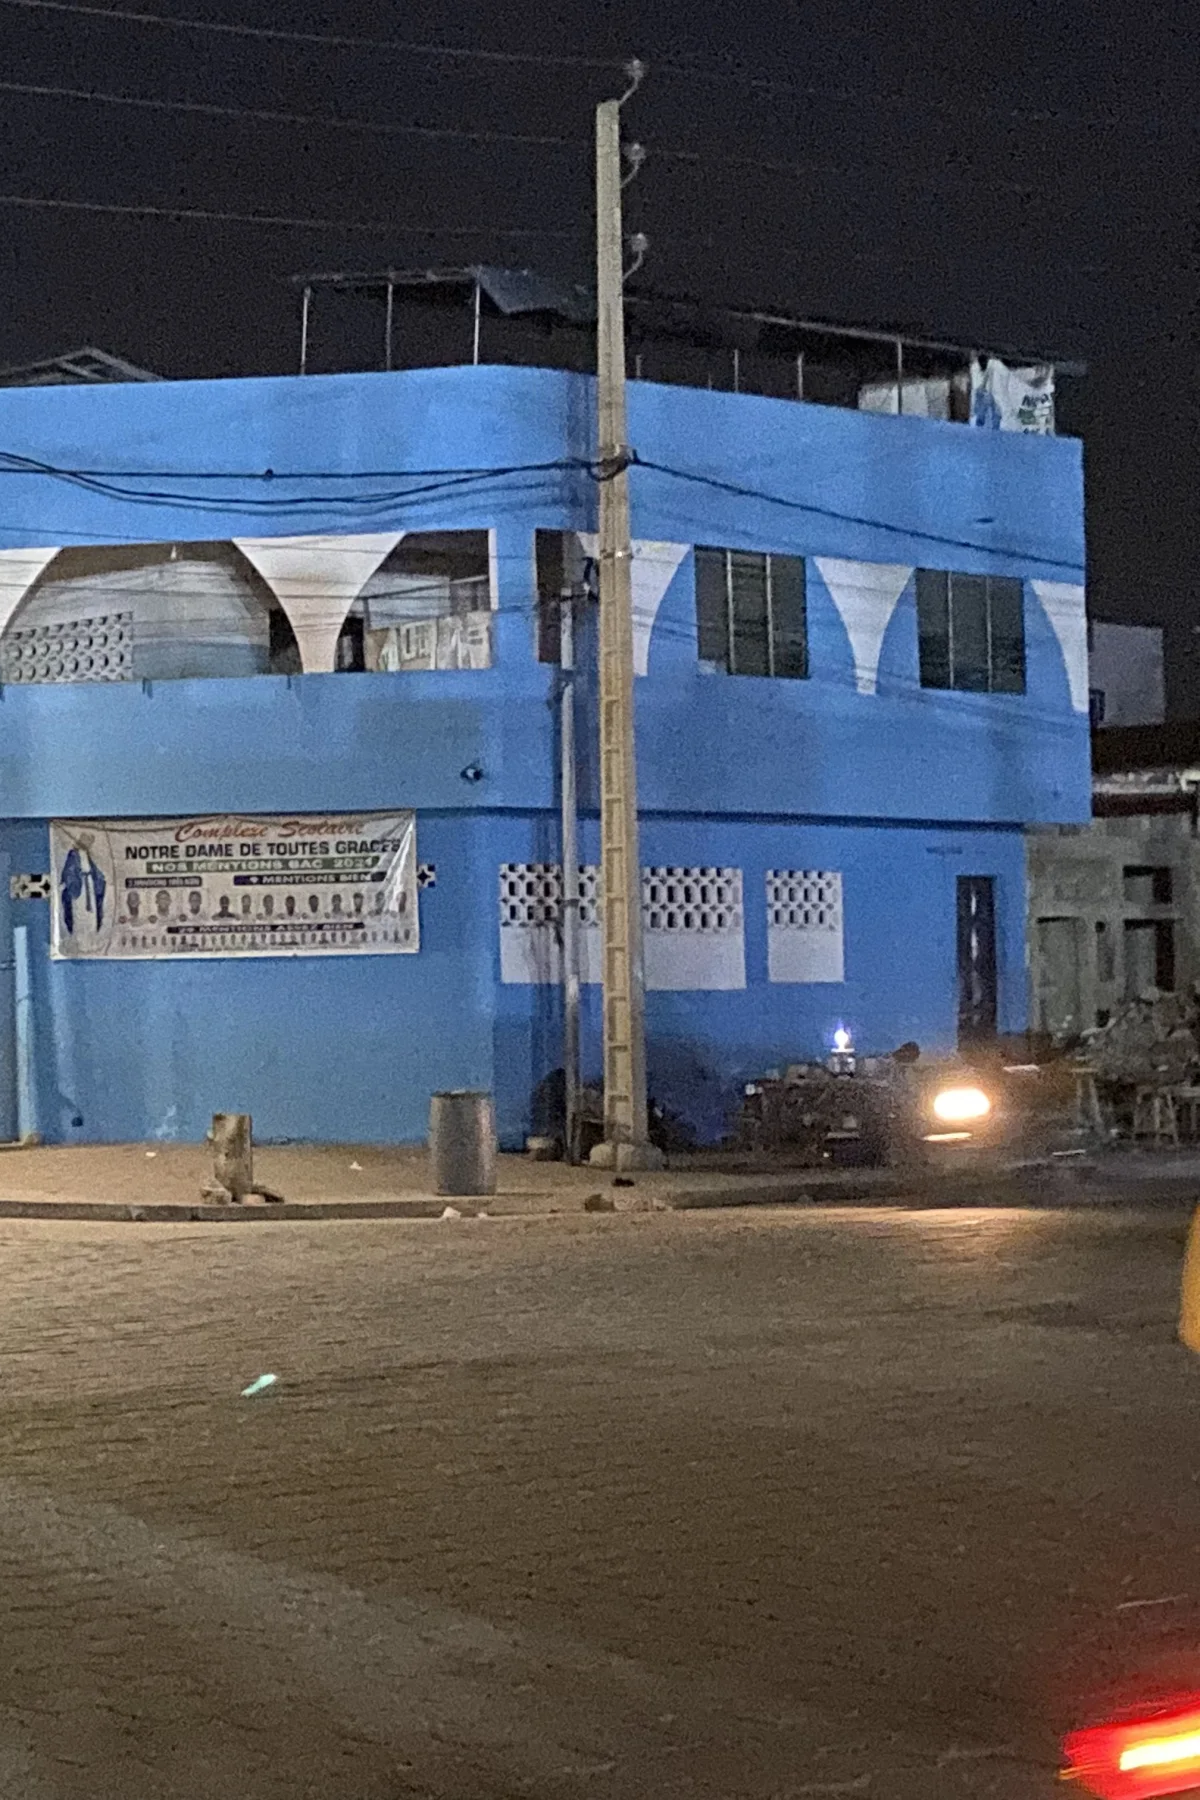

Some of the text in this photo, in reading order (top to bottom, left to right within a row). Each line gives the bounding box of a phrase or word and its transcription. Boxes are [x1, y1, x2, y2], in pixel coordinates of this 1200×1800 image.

[125, 845, 180, 859] NOTRE
[185, 843, 234, 858] DAME
[240, 842, 261, 857] DE
[267, 841, 330, 856] TOUTES
[151, 862, 188, 872] NOS
[192, 860, 283, 872] MENTIONS
[288, 859, 323, 869] BAC
[262, 874, 335, 884] MENTIONS
[339, 873, 372, 882] BIEN
